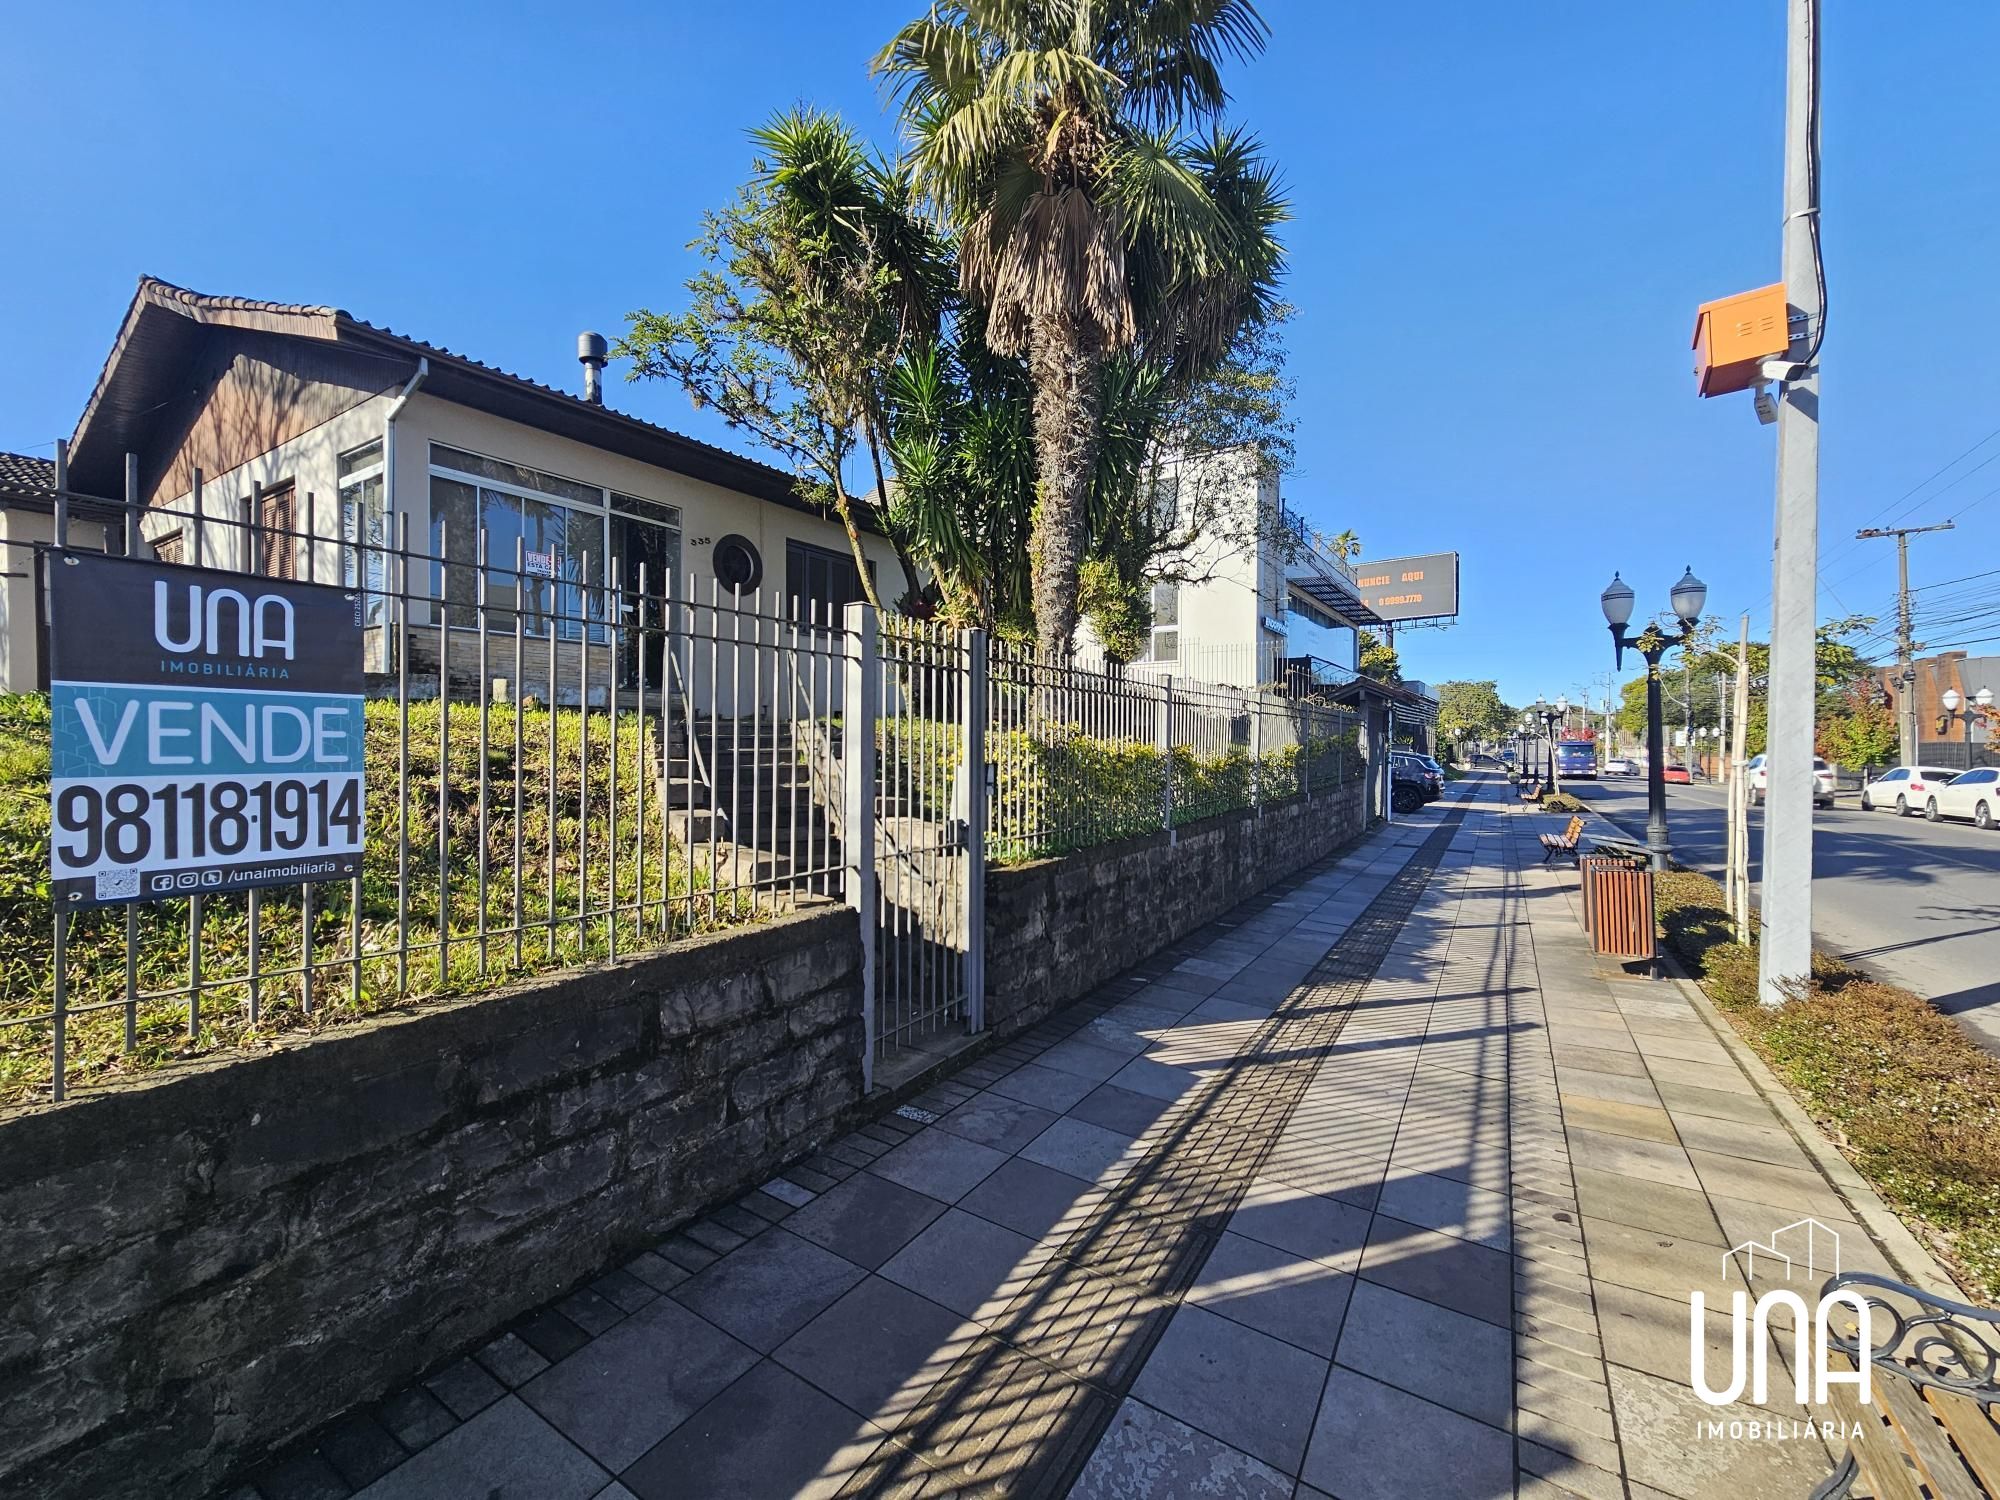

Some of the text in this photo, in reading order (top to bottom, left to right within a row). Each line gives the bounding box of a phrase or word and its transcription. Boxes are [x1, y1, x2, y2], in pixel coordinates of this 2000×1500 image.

[690, 537, 711, 546] 335
[1358, 571, 1424, 587] NUNCIE AQUI
[154, 580, 295, 660] UNA
[160, 660, 289, 679] IMOBILIÁRIA
[74, 697, 349, 765] VENDE
[227, 861, 336, 884] /unaimobiliaria
